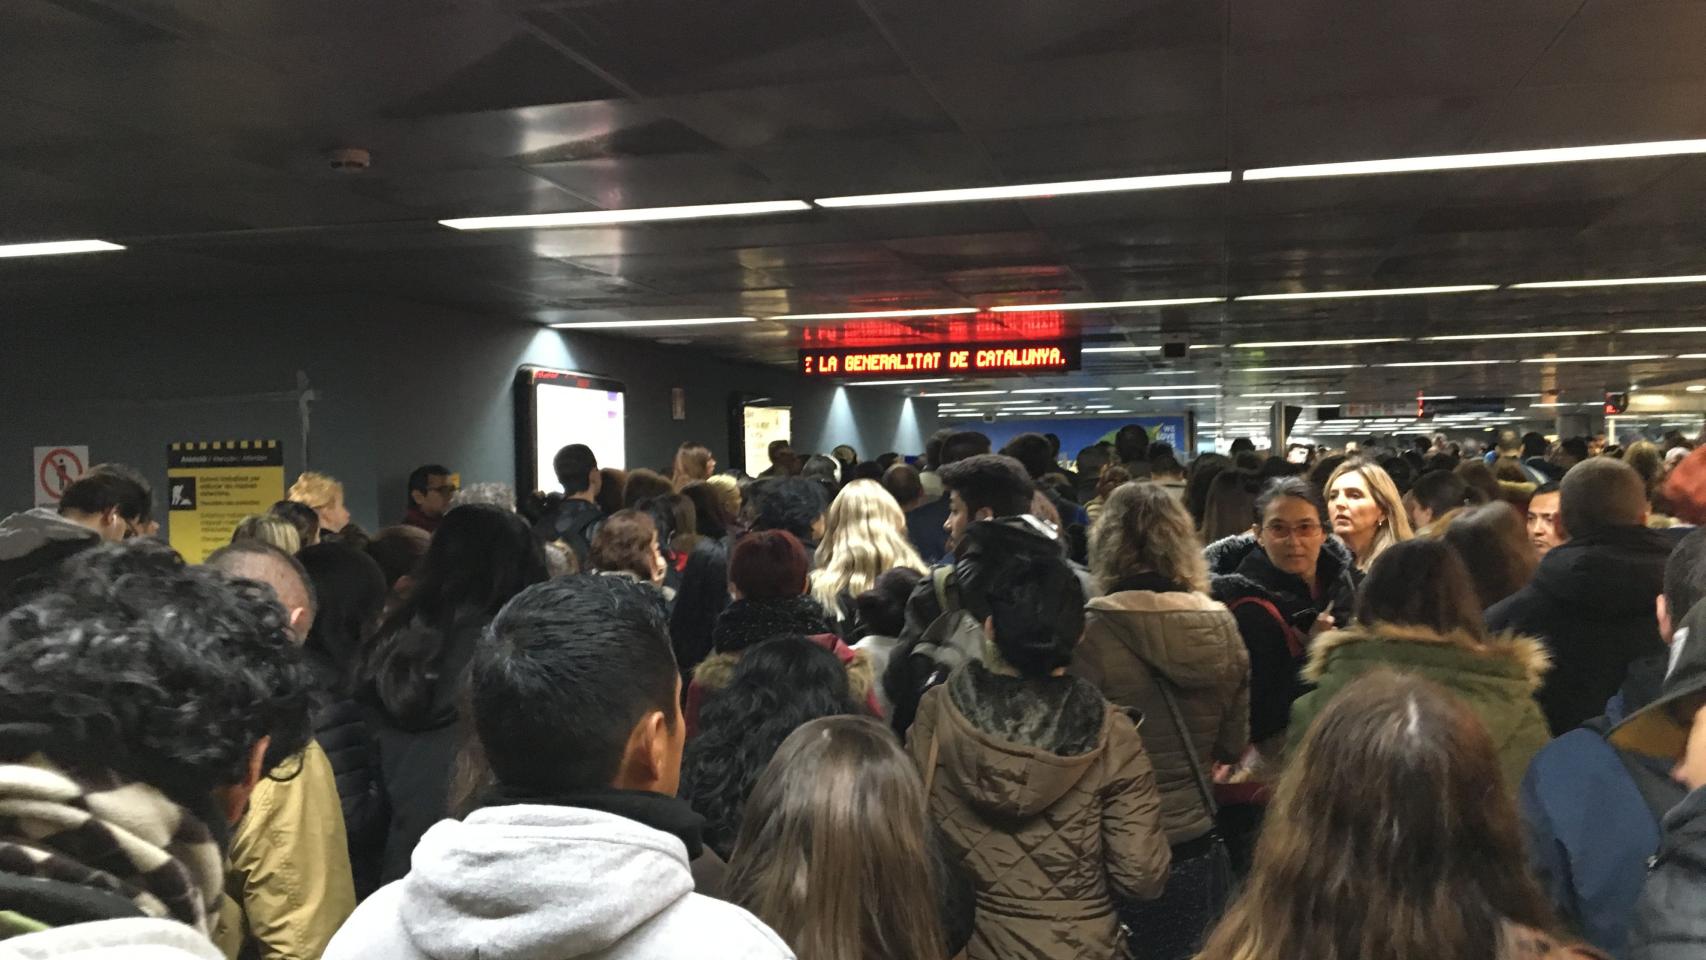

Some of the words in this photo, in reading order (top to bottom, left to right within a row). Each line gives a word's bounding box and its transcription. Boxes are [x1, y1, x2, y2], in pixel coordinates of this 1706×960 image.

[818, 355, 838, 373] LA
[844, 352, 941, 372] GENERALITAT
[949, 350, 969, 368] DE
[976, 347, 1066, 367] CATALUNYA.
